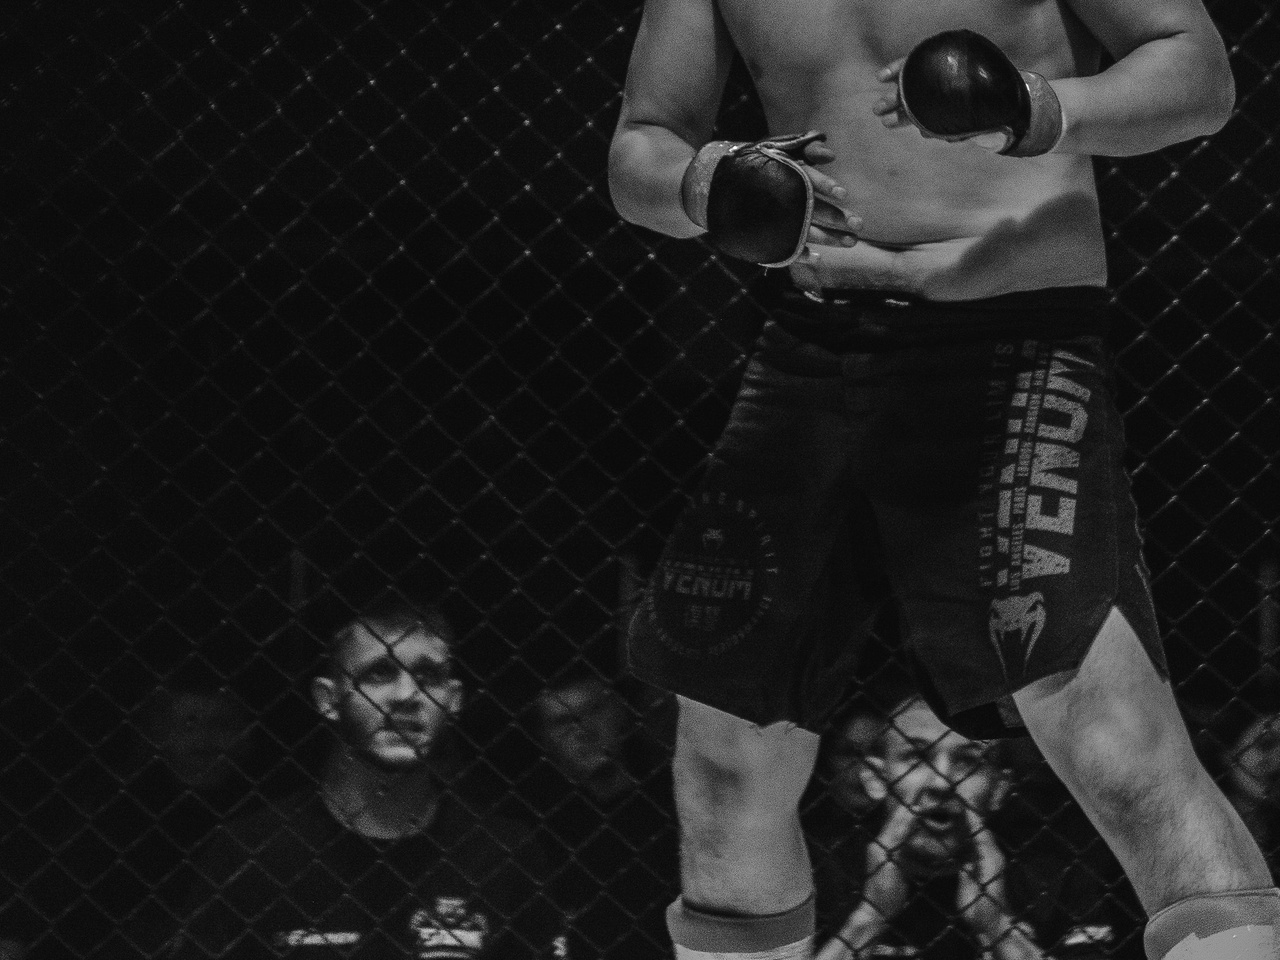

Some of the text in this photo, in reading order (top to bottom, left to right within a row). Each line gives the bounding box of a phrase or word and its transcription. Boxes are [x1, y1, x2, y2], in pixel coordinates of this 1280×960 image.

[984, 343, 1015, 422] LIMTS
[997, 339, 1096, 587] VENUM
[663, 559, 754, 600] VENUM
[977, 511, 994, 588] FIGHT
